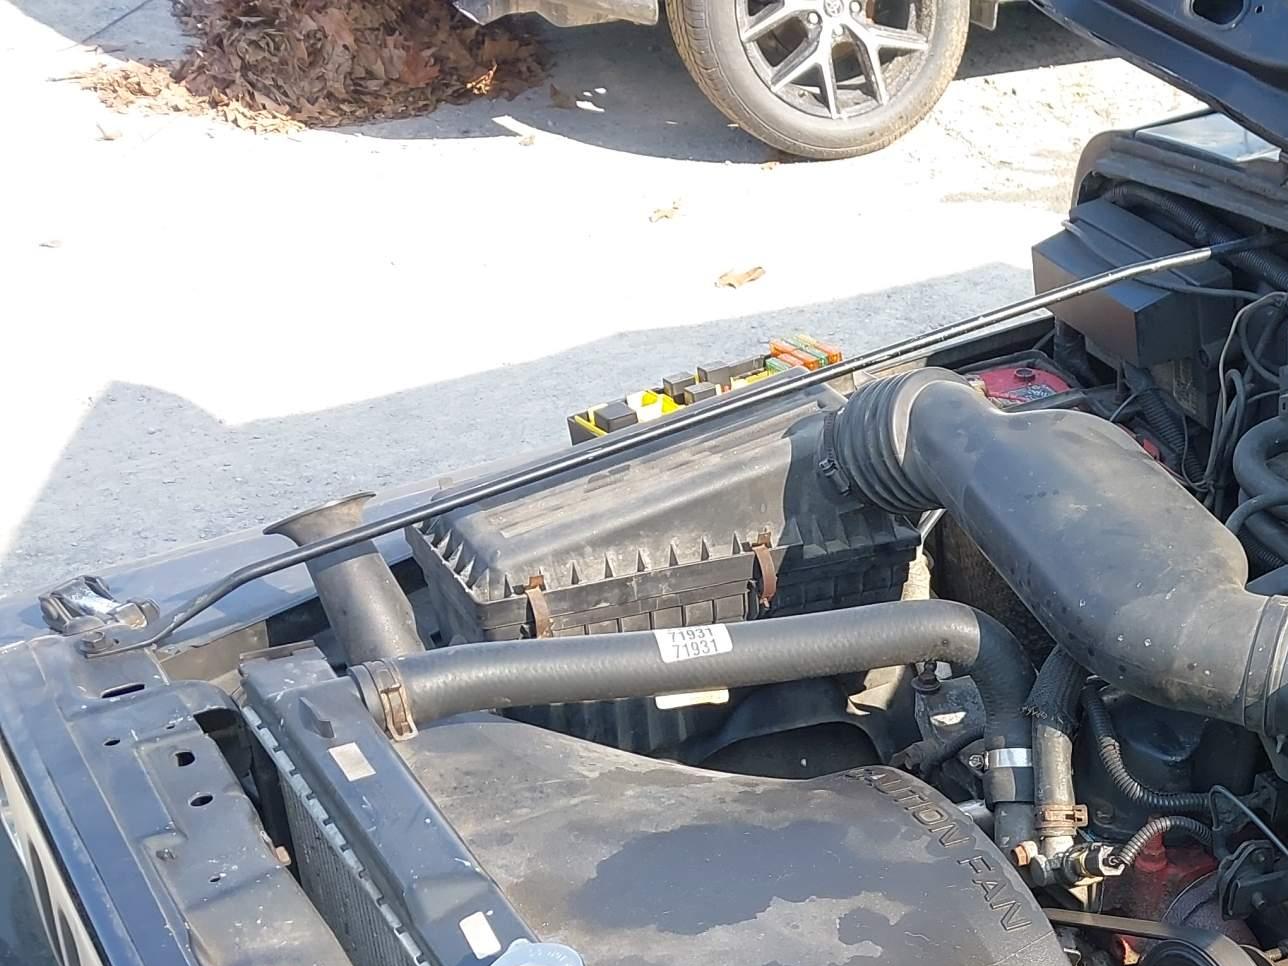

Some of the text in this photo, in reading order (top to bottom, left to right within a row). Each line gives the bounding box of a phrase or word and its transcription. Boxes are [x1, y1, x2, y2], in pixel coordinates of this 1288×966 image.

[671, 627, 714, 643] 71931
[671, 638, 719, 659] 71931
[957, 855, 1032, 932] FAN
